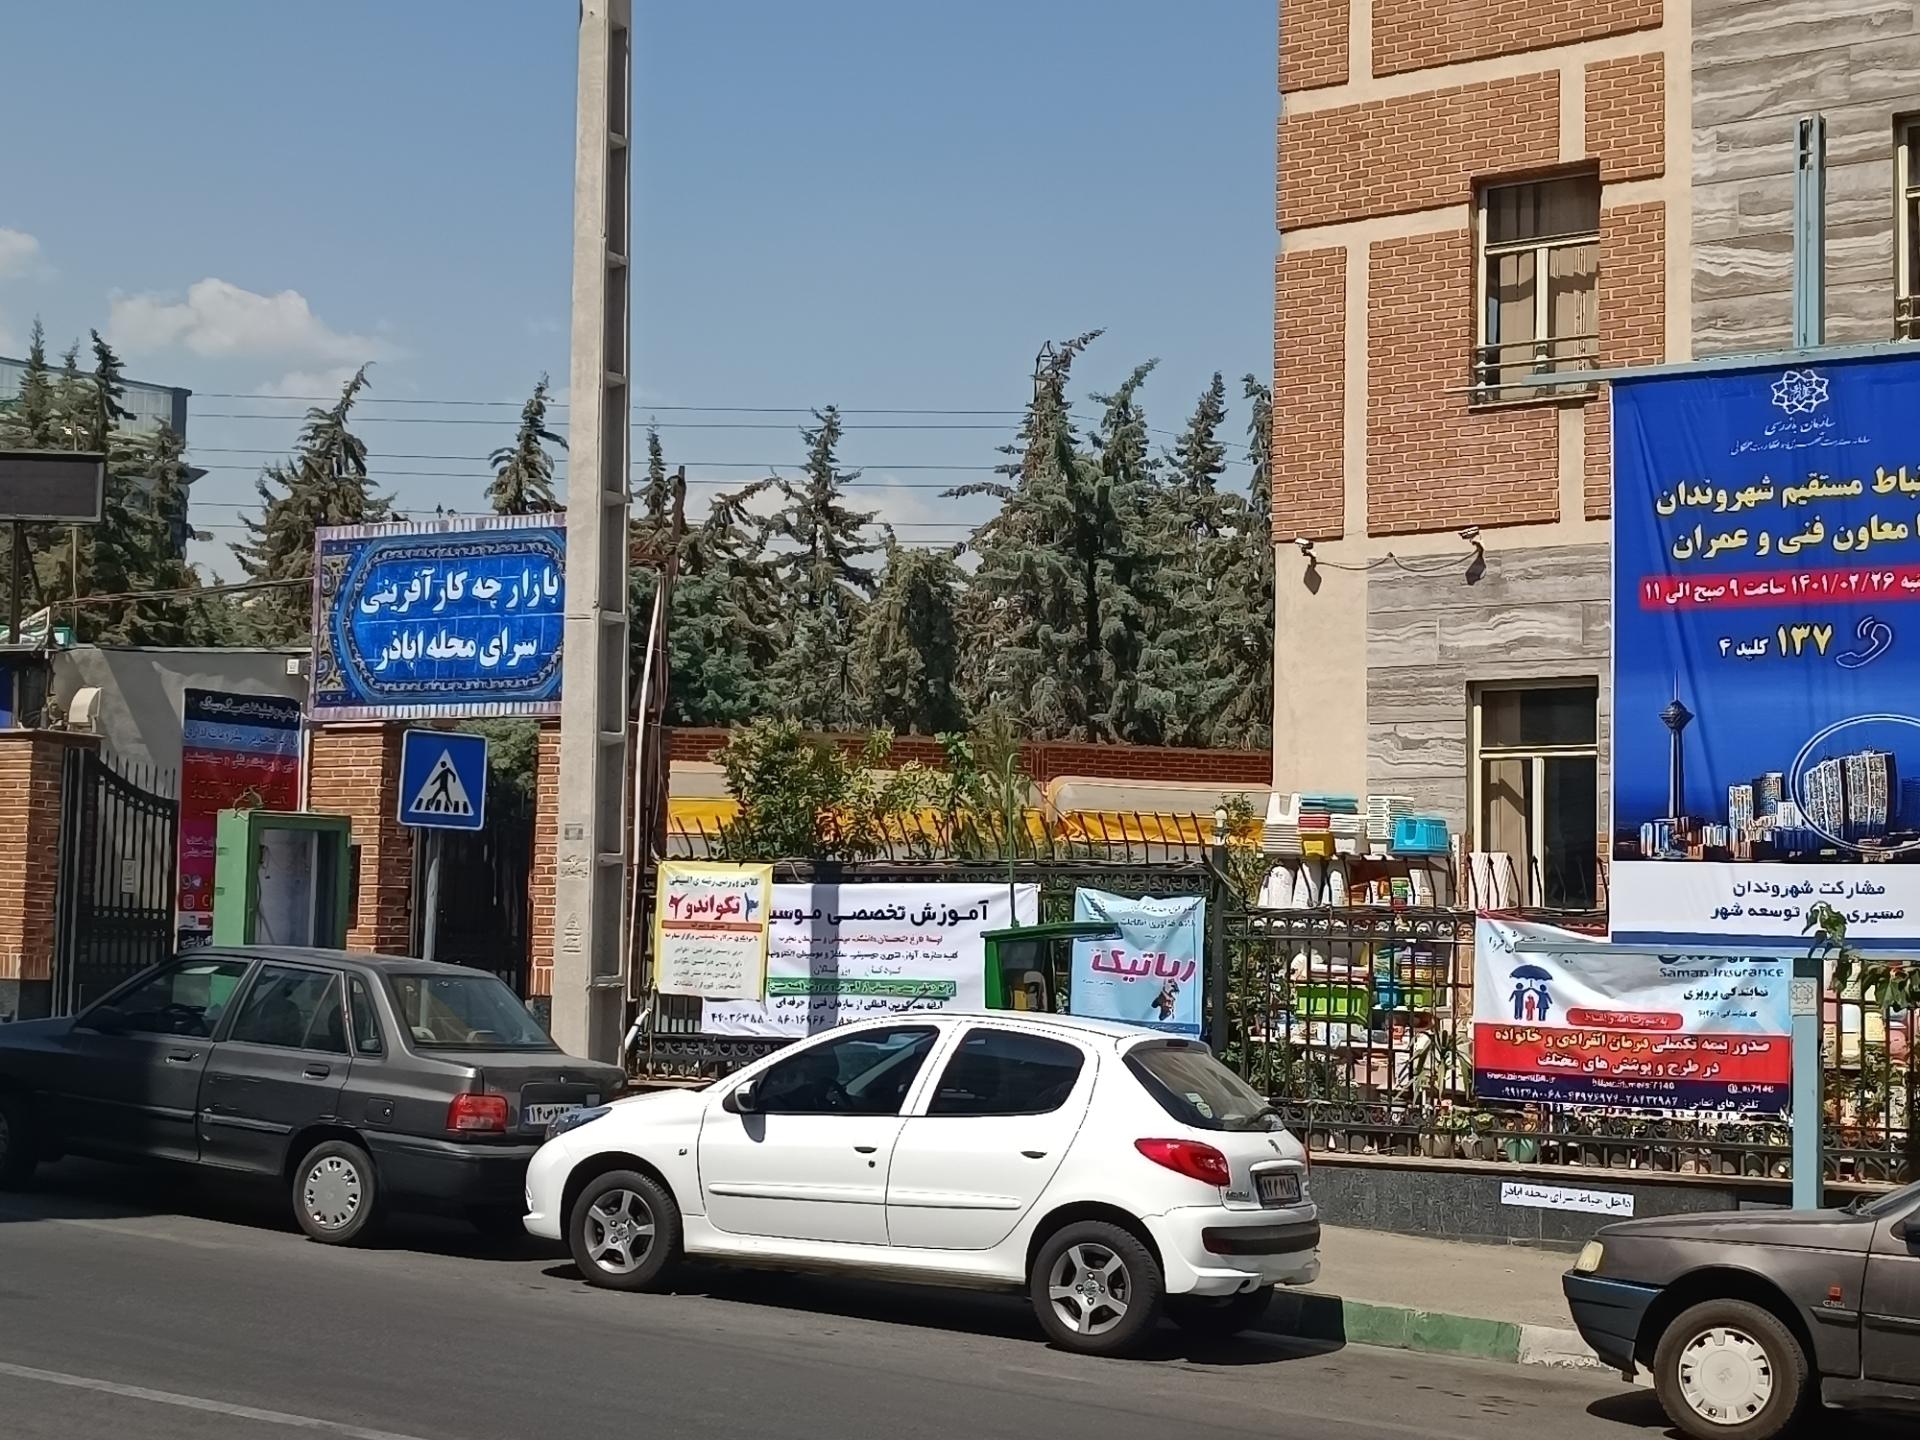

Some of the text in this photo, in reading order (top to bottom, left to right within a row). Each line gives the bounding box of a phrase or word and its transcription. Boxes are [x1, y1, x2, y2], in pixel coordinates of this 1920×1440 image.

[1655, 474, 1775, 515] شهروندان
[1781, 472, 1864, 509] مستقیم
[1672, 523, 1750, 559] عمران
[1755, 530, 1771, 556] و
[1777, 514, 1826, 554] فنی
[1832, 513, 1910, 552] معاون
[1644, 581, 1661, 600] ۱۱
[1665, 582, 1691, 605] الی
[1692, 584, 1726, 602] صبح
[1730, 578, 1739, 597] ۹
[1742, 577, 1787, 596] ساعت
[373, 626, 538, 671] سرای محله اباذر
[1718, 624, 1833, 660] ۱۳۷ کلید ۴
[1732, 879, 1886, 899] مشارکت شهروندان
[684, 893, 742, 920] تکواندو
[768, 899, 990, 926] آموزش تخصصی موسی
[1710, 902, 1744, 921] شهر
[1747, 905, 1800, 922] توسعه
[1846, 908, 1905, 924] مسیری
[1090, 949, 1197, 984] رباتیک
[1658, 967, 1785, 979] Saman Insurance
[1494, 1027, 1771, 1056] صدور بیمه تکمیلی درمان انفرادی و خانواده
[1536, 1051, 1720, 1078] در طرح و پوشش های مختلف
[1716, 1098, 1736, 1112] های
[1605, 1196, 1632, 1210] داخل
